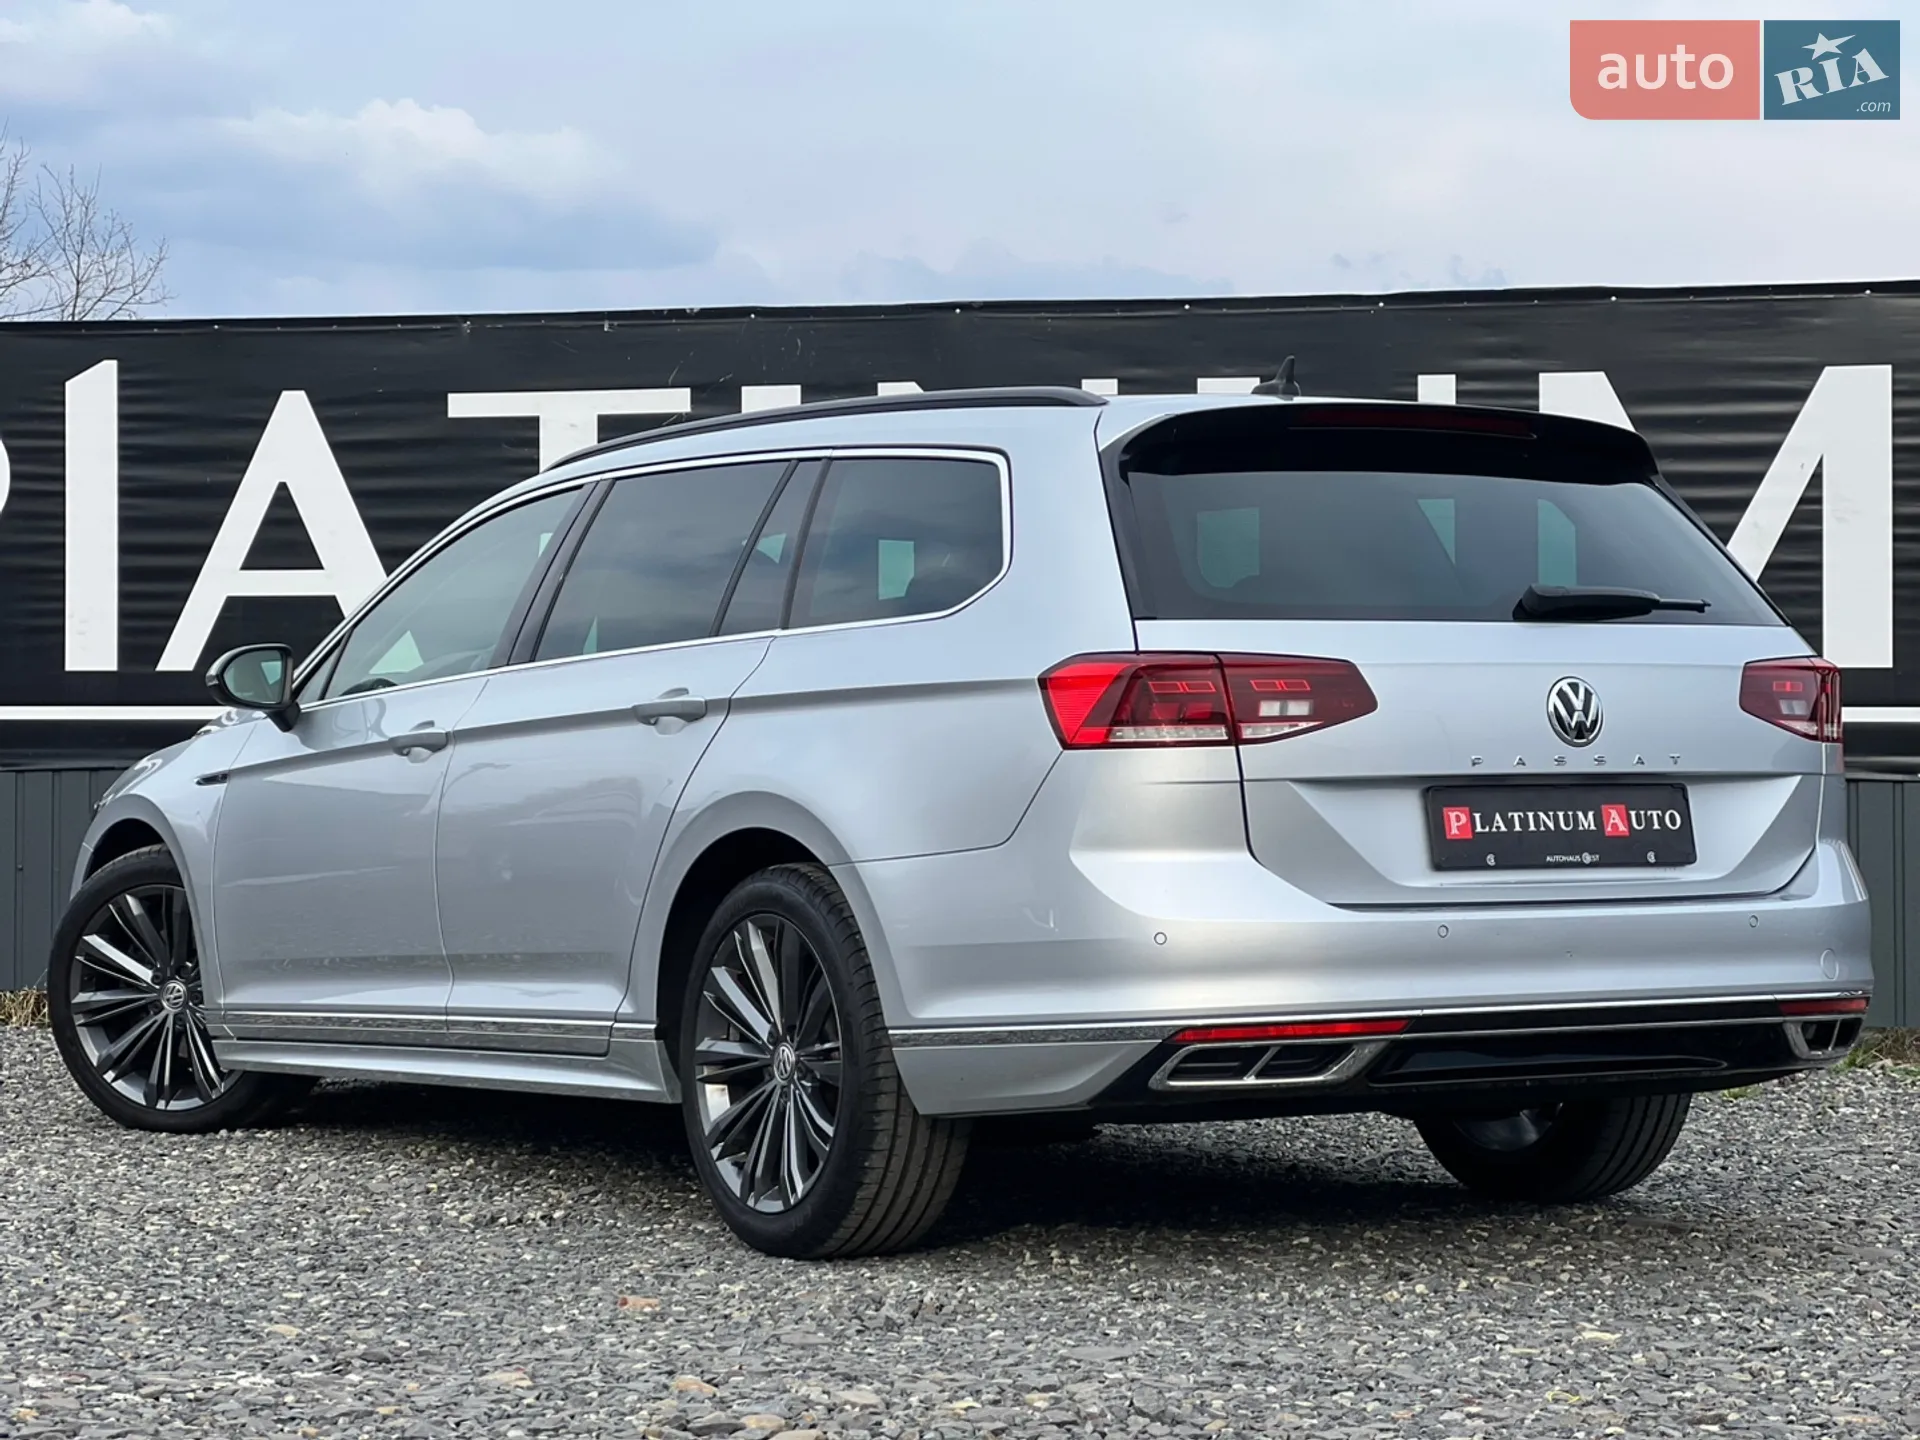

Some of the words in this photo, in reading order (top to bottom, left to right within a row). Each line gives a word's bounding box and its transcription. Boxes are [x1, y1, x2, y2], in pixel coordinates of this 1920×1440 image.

[1470, 753, 1682, 768] PASSAT
[1448, 809, 1597, 836] PLATINUM
[1606, 808, 1682, 832] AUTO
